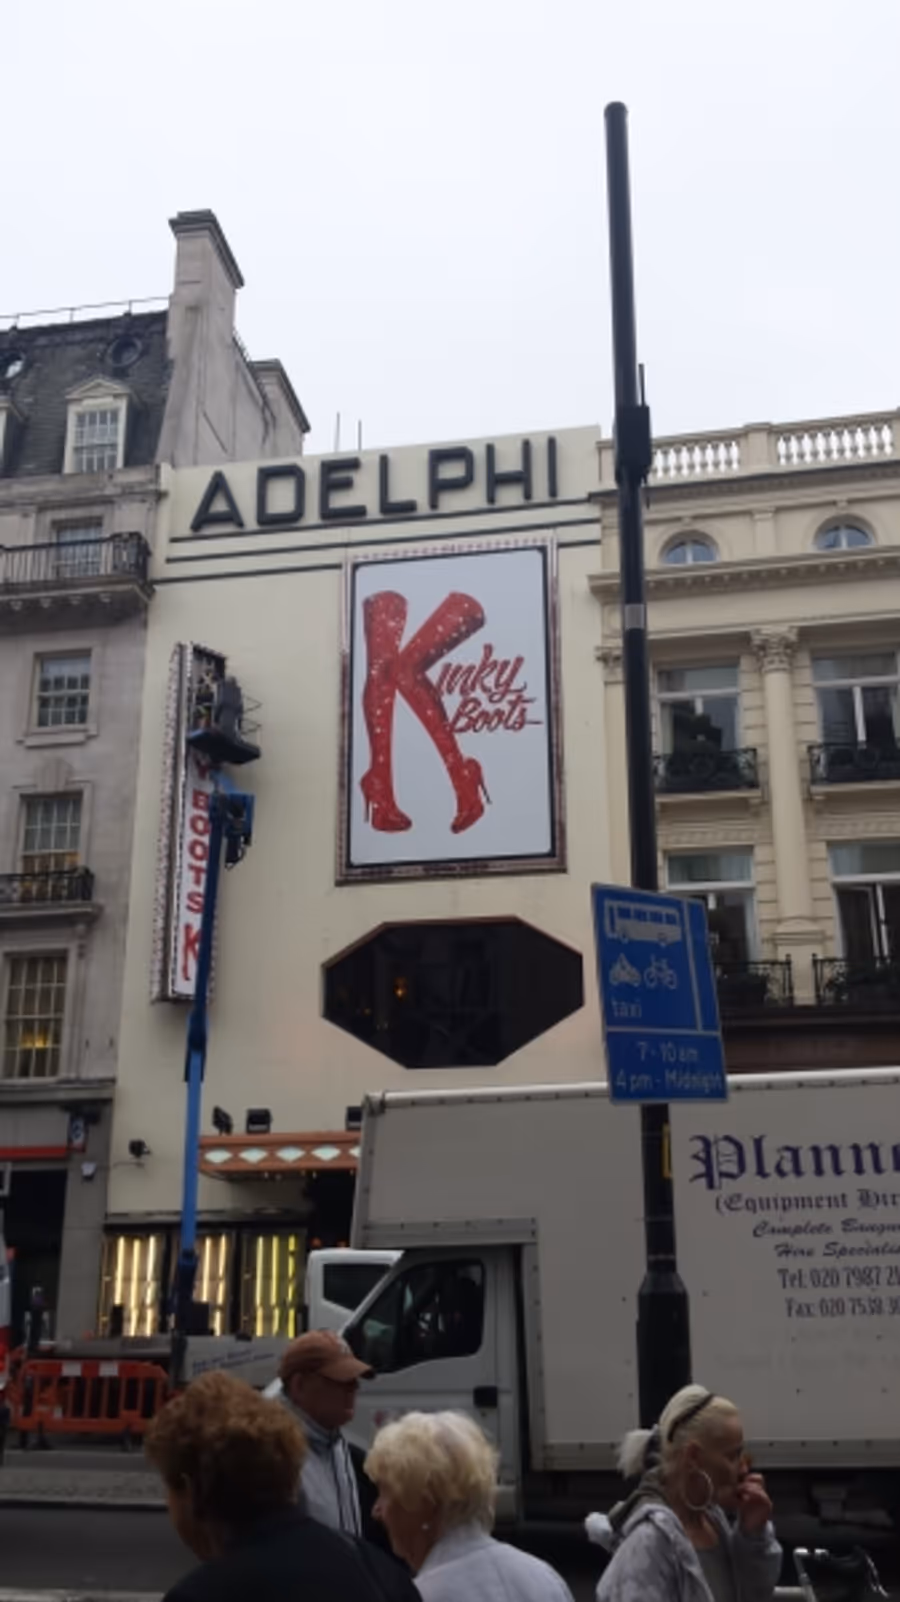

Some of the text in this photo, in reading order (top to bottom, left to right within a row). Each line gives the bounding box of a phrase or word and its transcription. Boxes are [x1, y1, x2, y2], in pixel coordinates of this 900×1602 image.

[190, 435, 558, 532] ADELPHI
[450, 694, 544, 734] Boots
[186, 789, 212, 914] BOOTS
[611, 997, 642, 1017] taxi
[810, 1267, 840, 1288] 020
